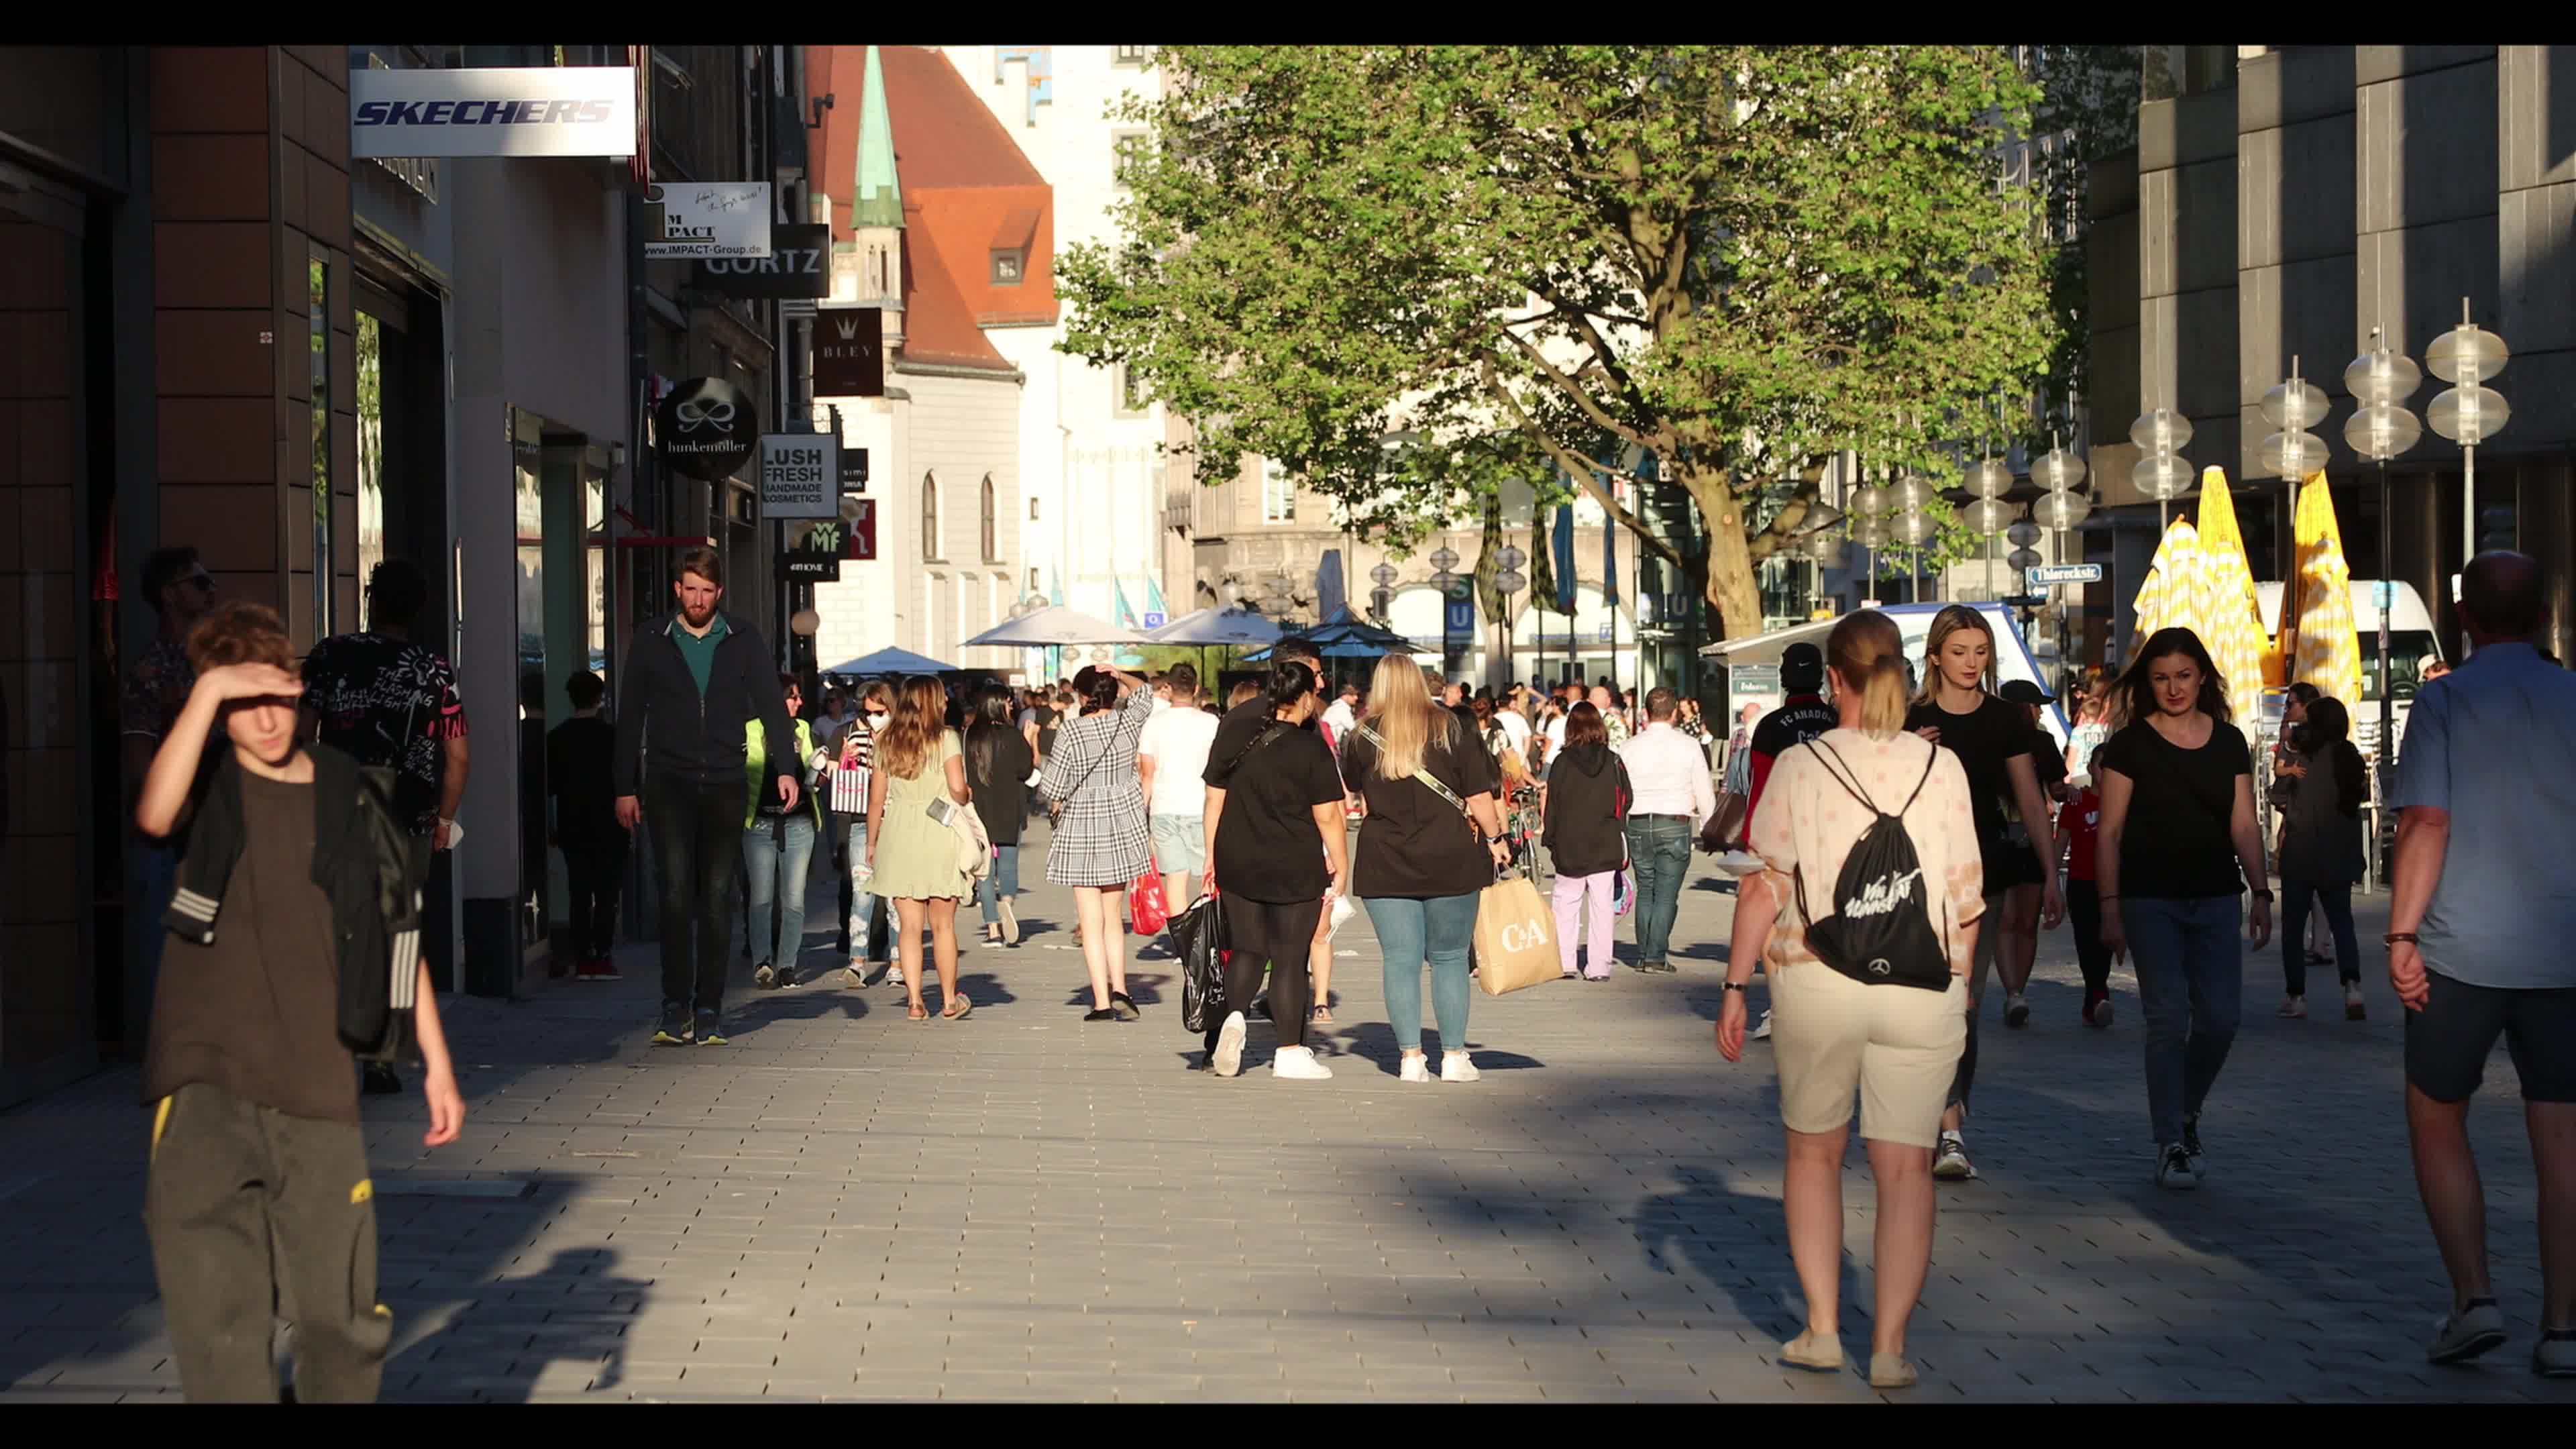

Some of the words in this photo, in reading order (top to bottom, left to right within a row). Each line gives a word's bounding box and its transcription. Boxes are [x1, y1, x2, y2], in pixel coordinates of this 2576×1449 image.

[354, 100, 614, 125] SKECHERS
[669, 227, 716, 237] PACT
[824, 346, 873, 358] BLEY
[668, 440, 746, 452] hunkemöller
[1452, 606, 1469, 627] U
